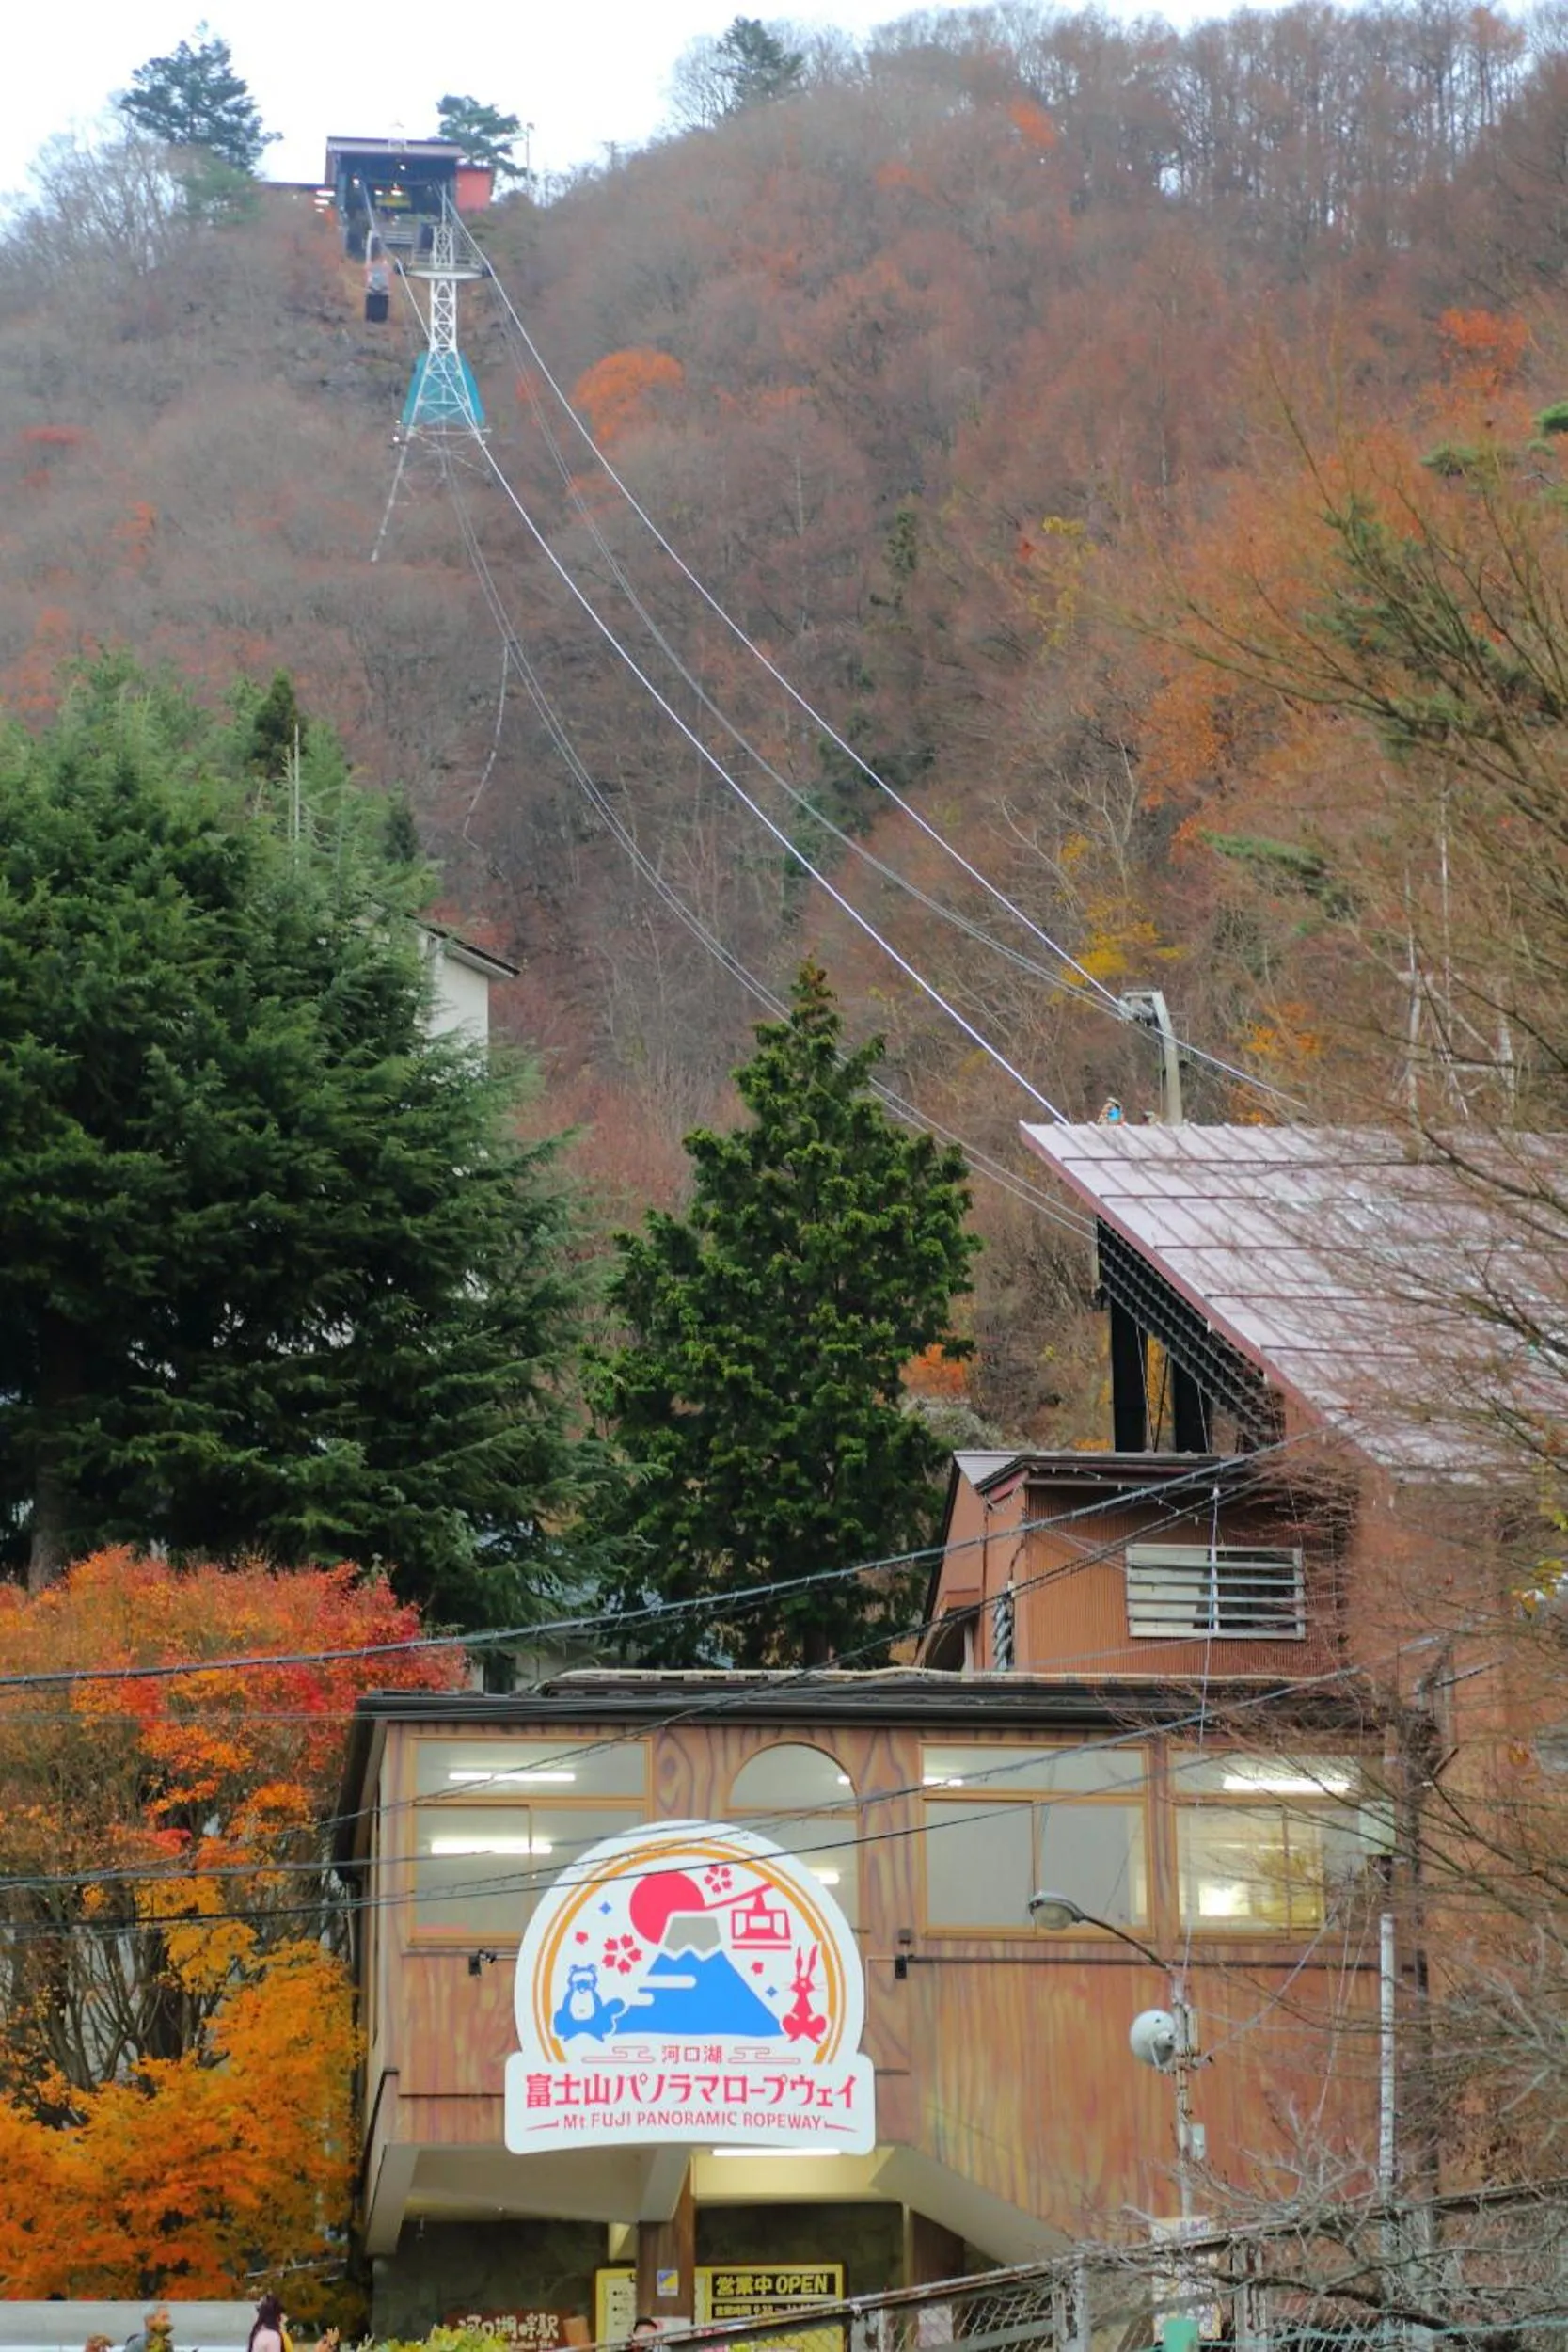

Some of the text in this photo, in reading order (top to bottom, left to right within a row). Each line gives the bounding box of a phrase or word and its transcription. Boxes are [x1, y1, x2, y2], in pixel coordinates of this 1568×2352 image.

[661, 2044, 722, 2064] 河口湖
[525, 2073, 857, 2109] 富士山パノラマロープウェイ
[591, 2111, 632, 2128] FUJI
[637, 2110, 737, 2127] PANORAMIC
[743, 2111, 822, 2131] ROPEWAY
[775, 2274, 828, 2295] OPEN
